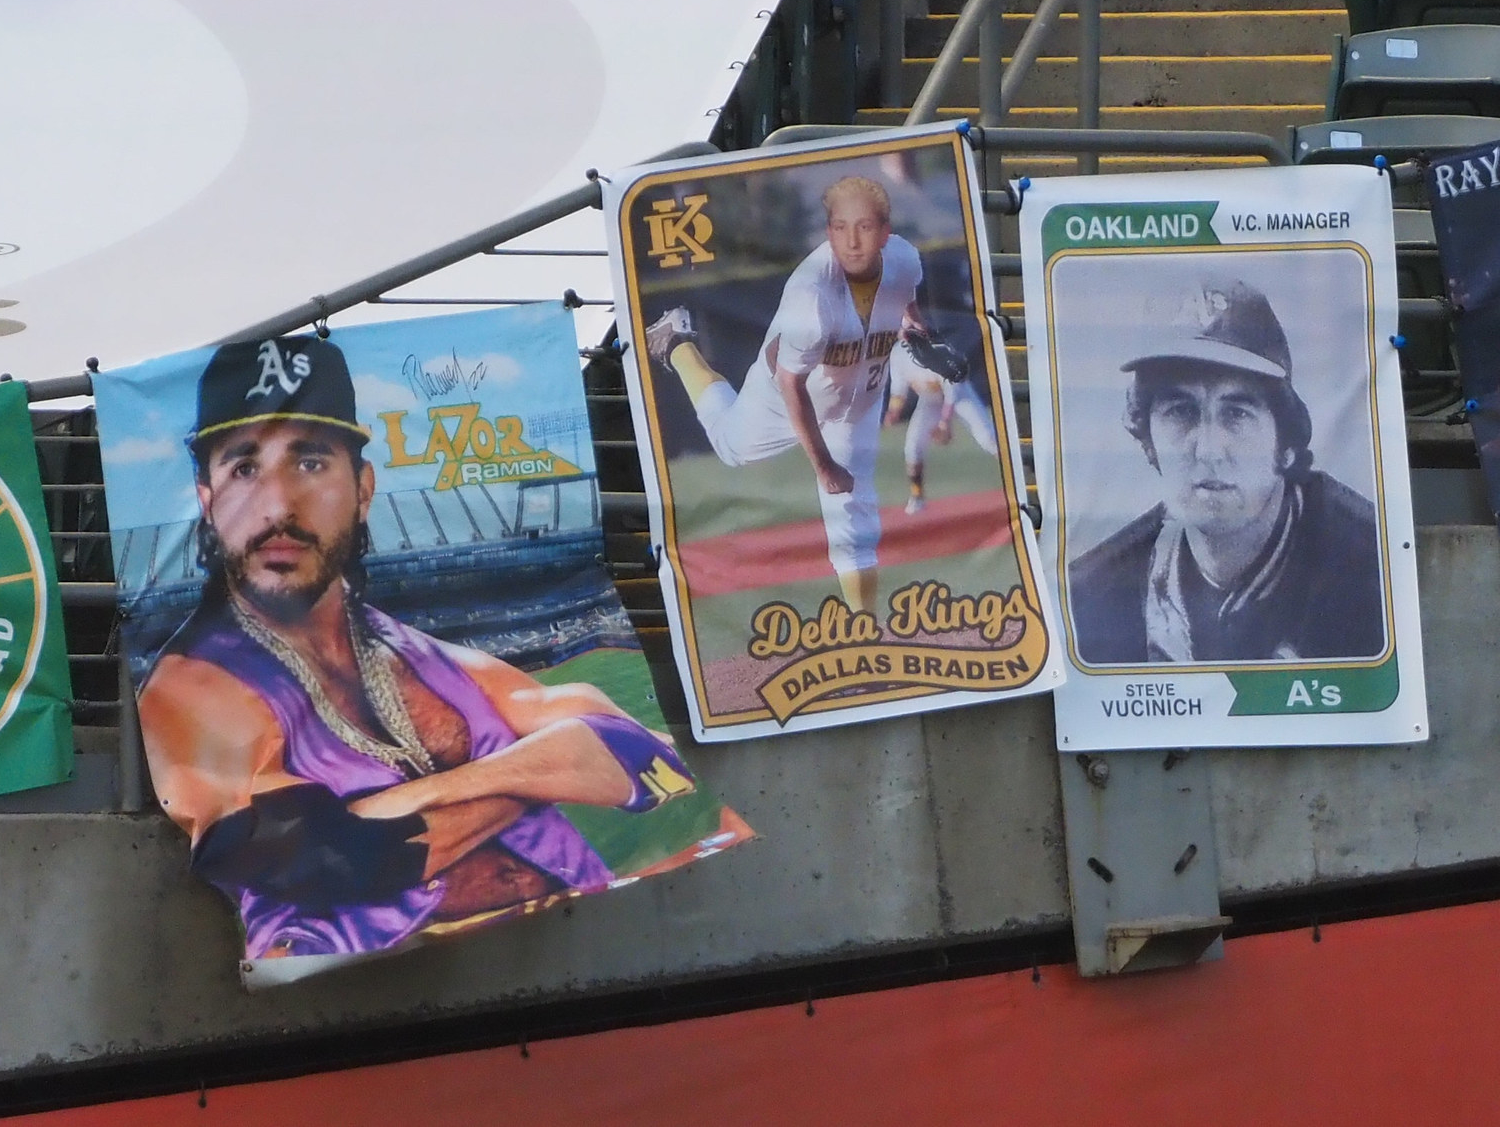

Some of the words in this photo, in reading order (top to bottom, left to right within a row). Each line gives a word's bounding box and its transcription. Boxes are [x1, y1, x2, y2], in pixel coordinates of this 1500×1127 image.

[1065, 213, 1199, 241] OAKLAND
[1231, 214, 1261, 232] V.C.
[1266, 211, 1350, 231] MANAGER
[245, 339, 311, 401] A's
[750, 596, 883, 658] Delta
[887, 580, 1030, 643] Kings
[781, 654, 892, 701] DALLAS
[902, 653, 1030, 681] BRADEN
[1125, 683, 1176, 697] STEVE
[1286, 679, 1342, 707] A's
[1101, 698, 1202, 718] VUCINICH
